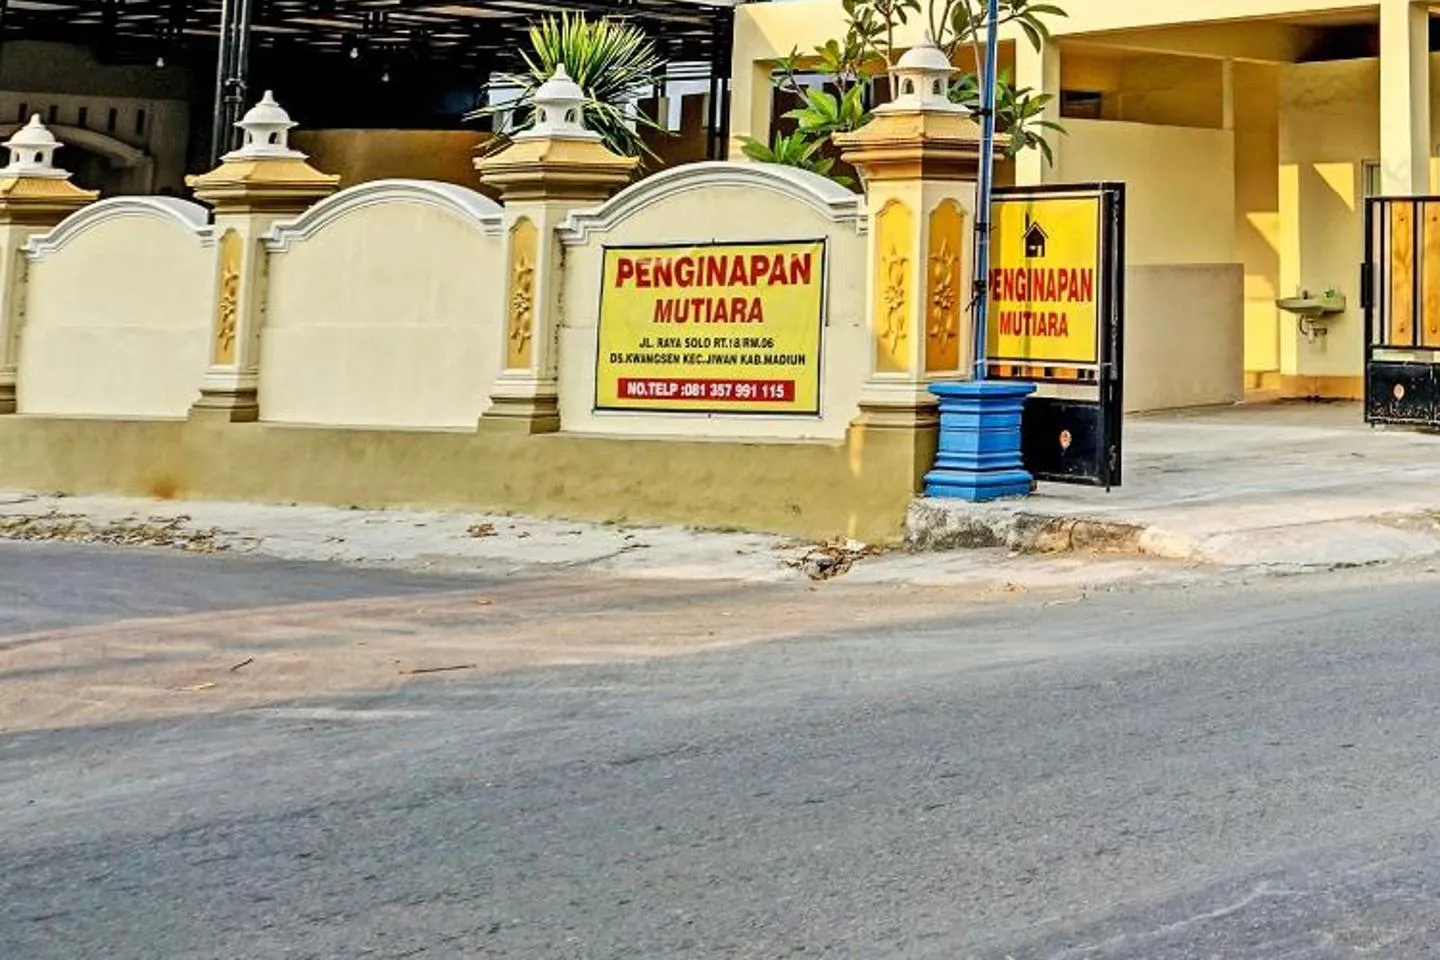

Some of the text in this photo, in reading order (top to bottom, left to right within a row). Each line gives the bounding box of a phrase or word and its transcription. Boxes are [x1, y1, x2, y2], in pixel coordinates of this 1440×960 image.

[615, 252, 812, 288] PENGINAPAN
[653, 297, 763, 324] MUTIARA
[1000, 311, 1069, 337] MUTIARA
[638, 338, 653, 349] JL.
[656, 338, 682, 349] RAYA
[685, 337, 710, 349] SOLO
[627, 382, 677, 396] NO.TELP
[710, 383, 731, 397] 357
[736, 383, 757, 398] 991
[762, 384, 785, 398] 115
